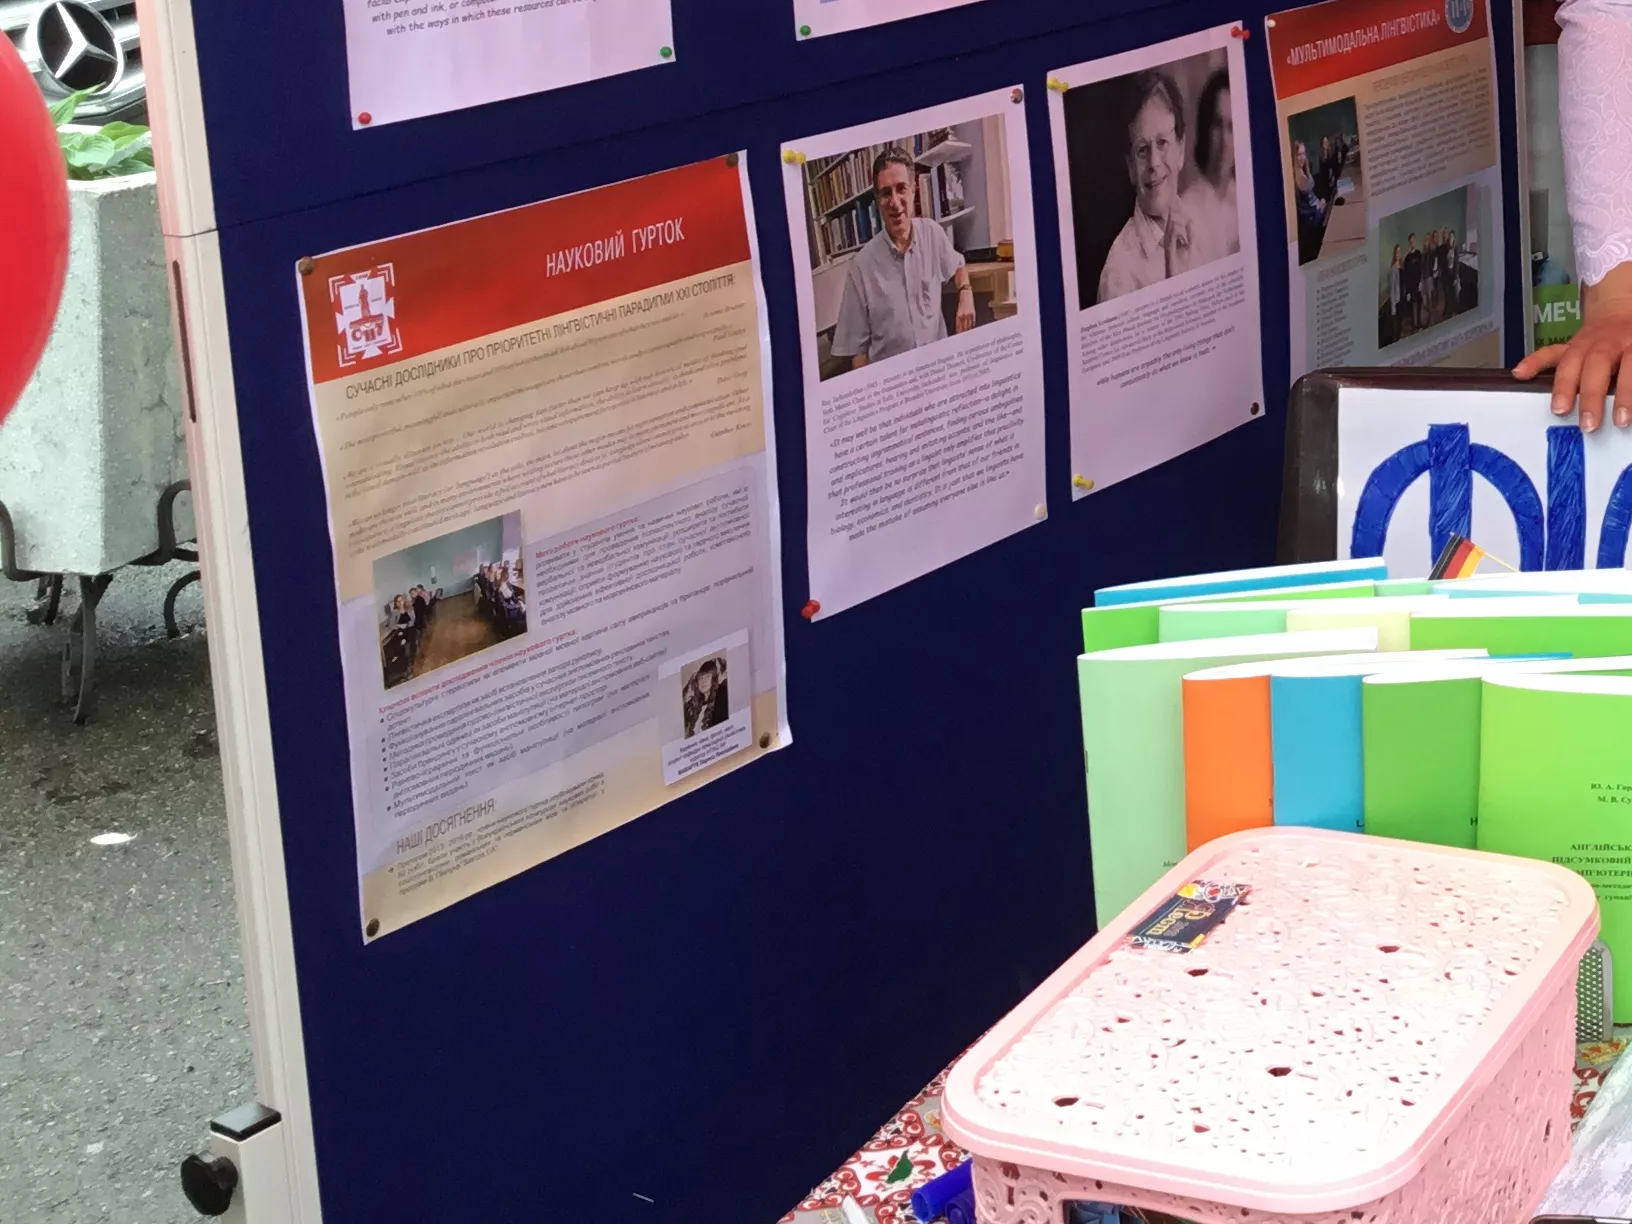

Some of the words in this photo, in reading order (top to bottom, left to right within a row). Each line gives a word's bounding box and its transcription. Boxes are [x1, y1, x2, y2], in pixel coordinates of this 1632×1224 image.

[371, 10, 391, 22] with
[392, 9, 409, 21] pen
[411, 4, 428, 15] and
[448, 1, 459, 9] or
[385, 23, 405, 35] with
[408, 21, 424, 31] the
[427, 18, 449, 29] ways
[451, 15, 459, 24] in
[461, 9, 485, 22] which
[486, 7, 510, 17] these
[513, 0, 554, 13] resources
[545, 228, 624, 278] НАУКОВИЙ
[631, 217, 685, 255] ГУРТОК
[345, 373, 392, 401] СУЧАСНІ
[394, 352, 461, 388] ДОСЛІДНИКИ
[463, 345, 485, 366] ПРО
[487, 326, 551, 359] ПРІОРИТЕТНІ
[553, 306, 617, 339] ЛІНГВІСТИЧНІ
[619, 291, 673, 320] ПАРАДИГМИ
[396, 828, 423, 855] НАШІ
[425, 797, 495, 845] ДОСЯГНЕННЯ
[1552, 856, 1632, 865] ПІДСУМКОВИЙ
